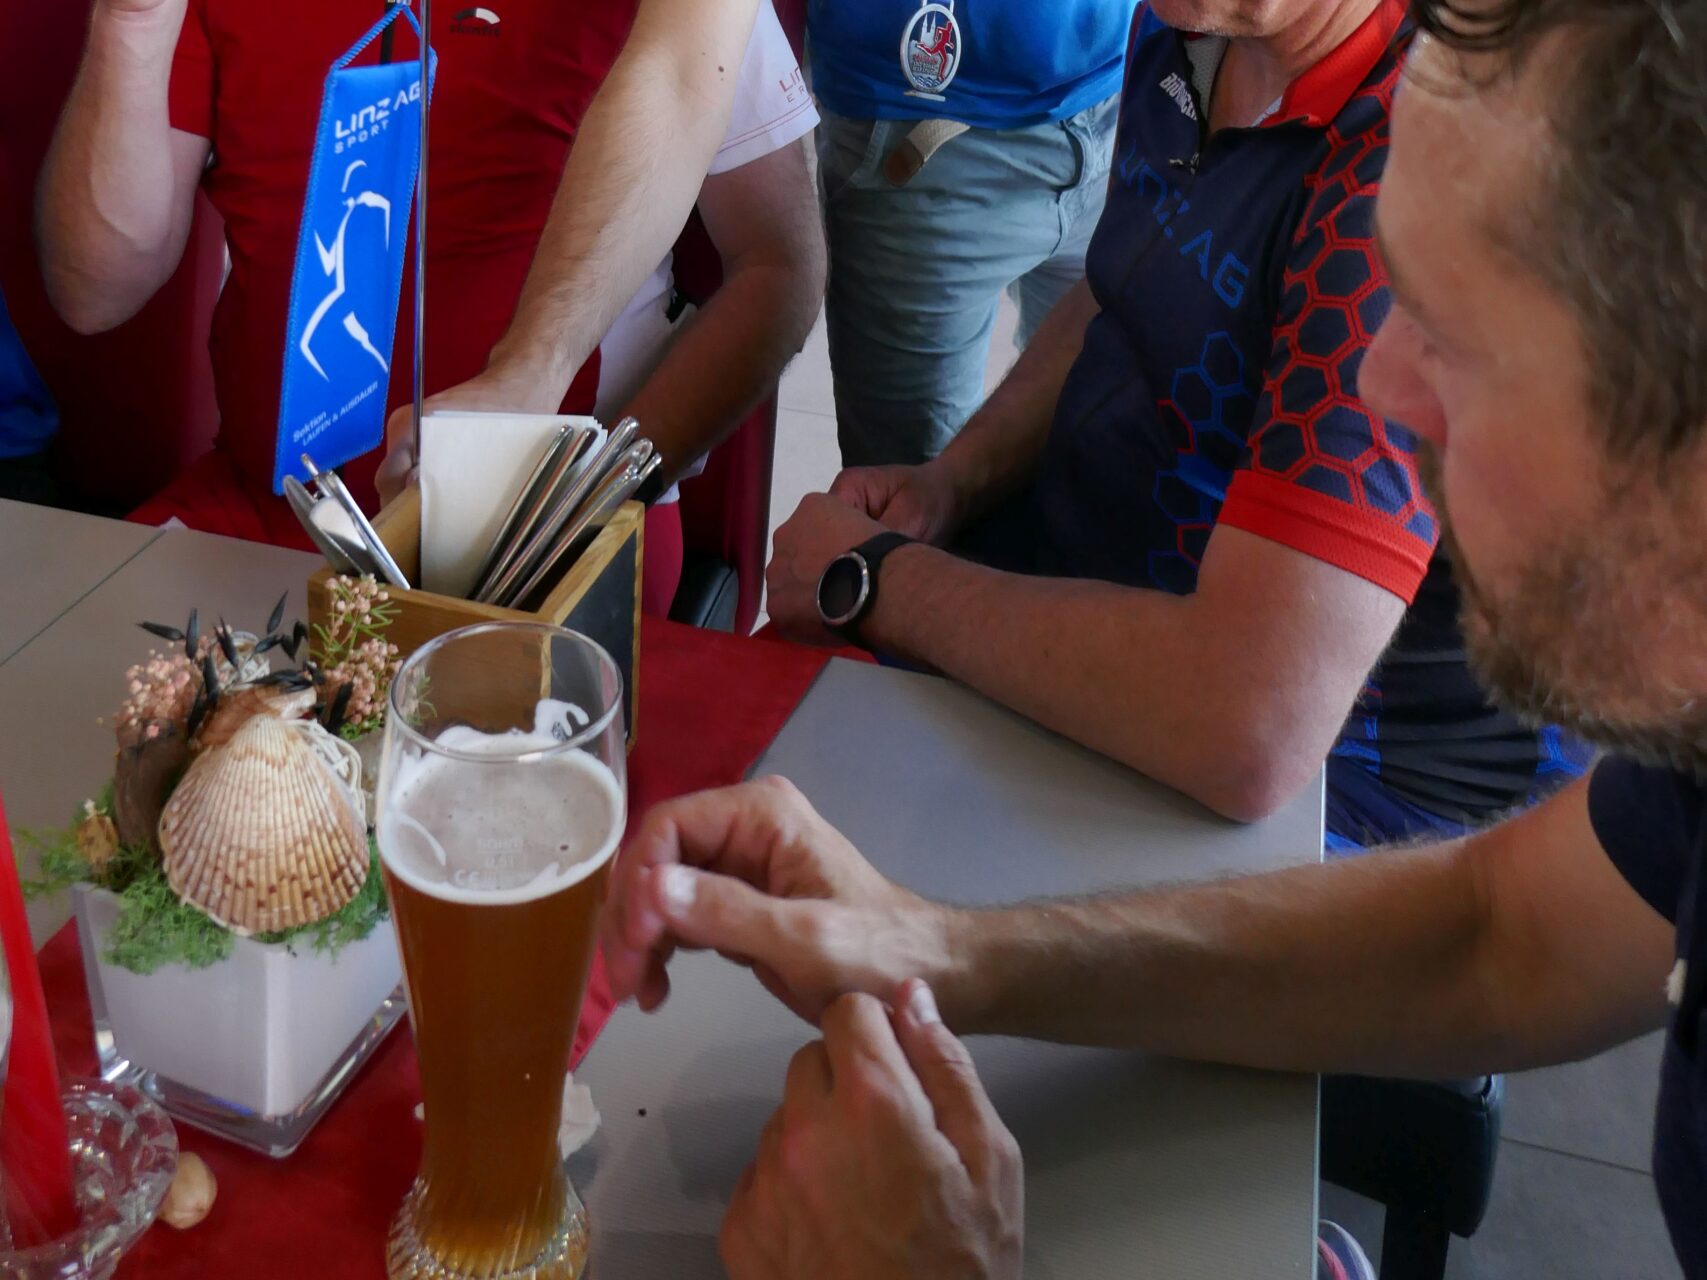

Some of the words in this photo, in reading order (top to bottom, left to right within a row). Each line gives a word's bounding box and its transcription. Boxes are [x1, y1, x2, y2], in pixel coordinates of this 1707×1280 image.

[334, 96, 392, 140] LINZ
[392, 79, 421, 112] AG
[334, 118, 390, 154] SPORT
[1178, 228, 1250, 309] AG
[292, 410, 328, 443] Sektion
[302, 417, 332, 447] LAUFEN
[340, 380, 379, 417] AUSDAUER
